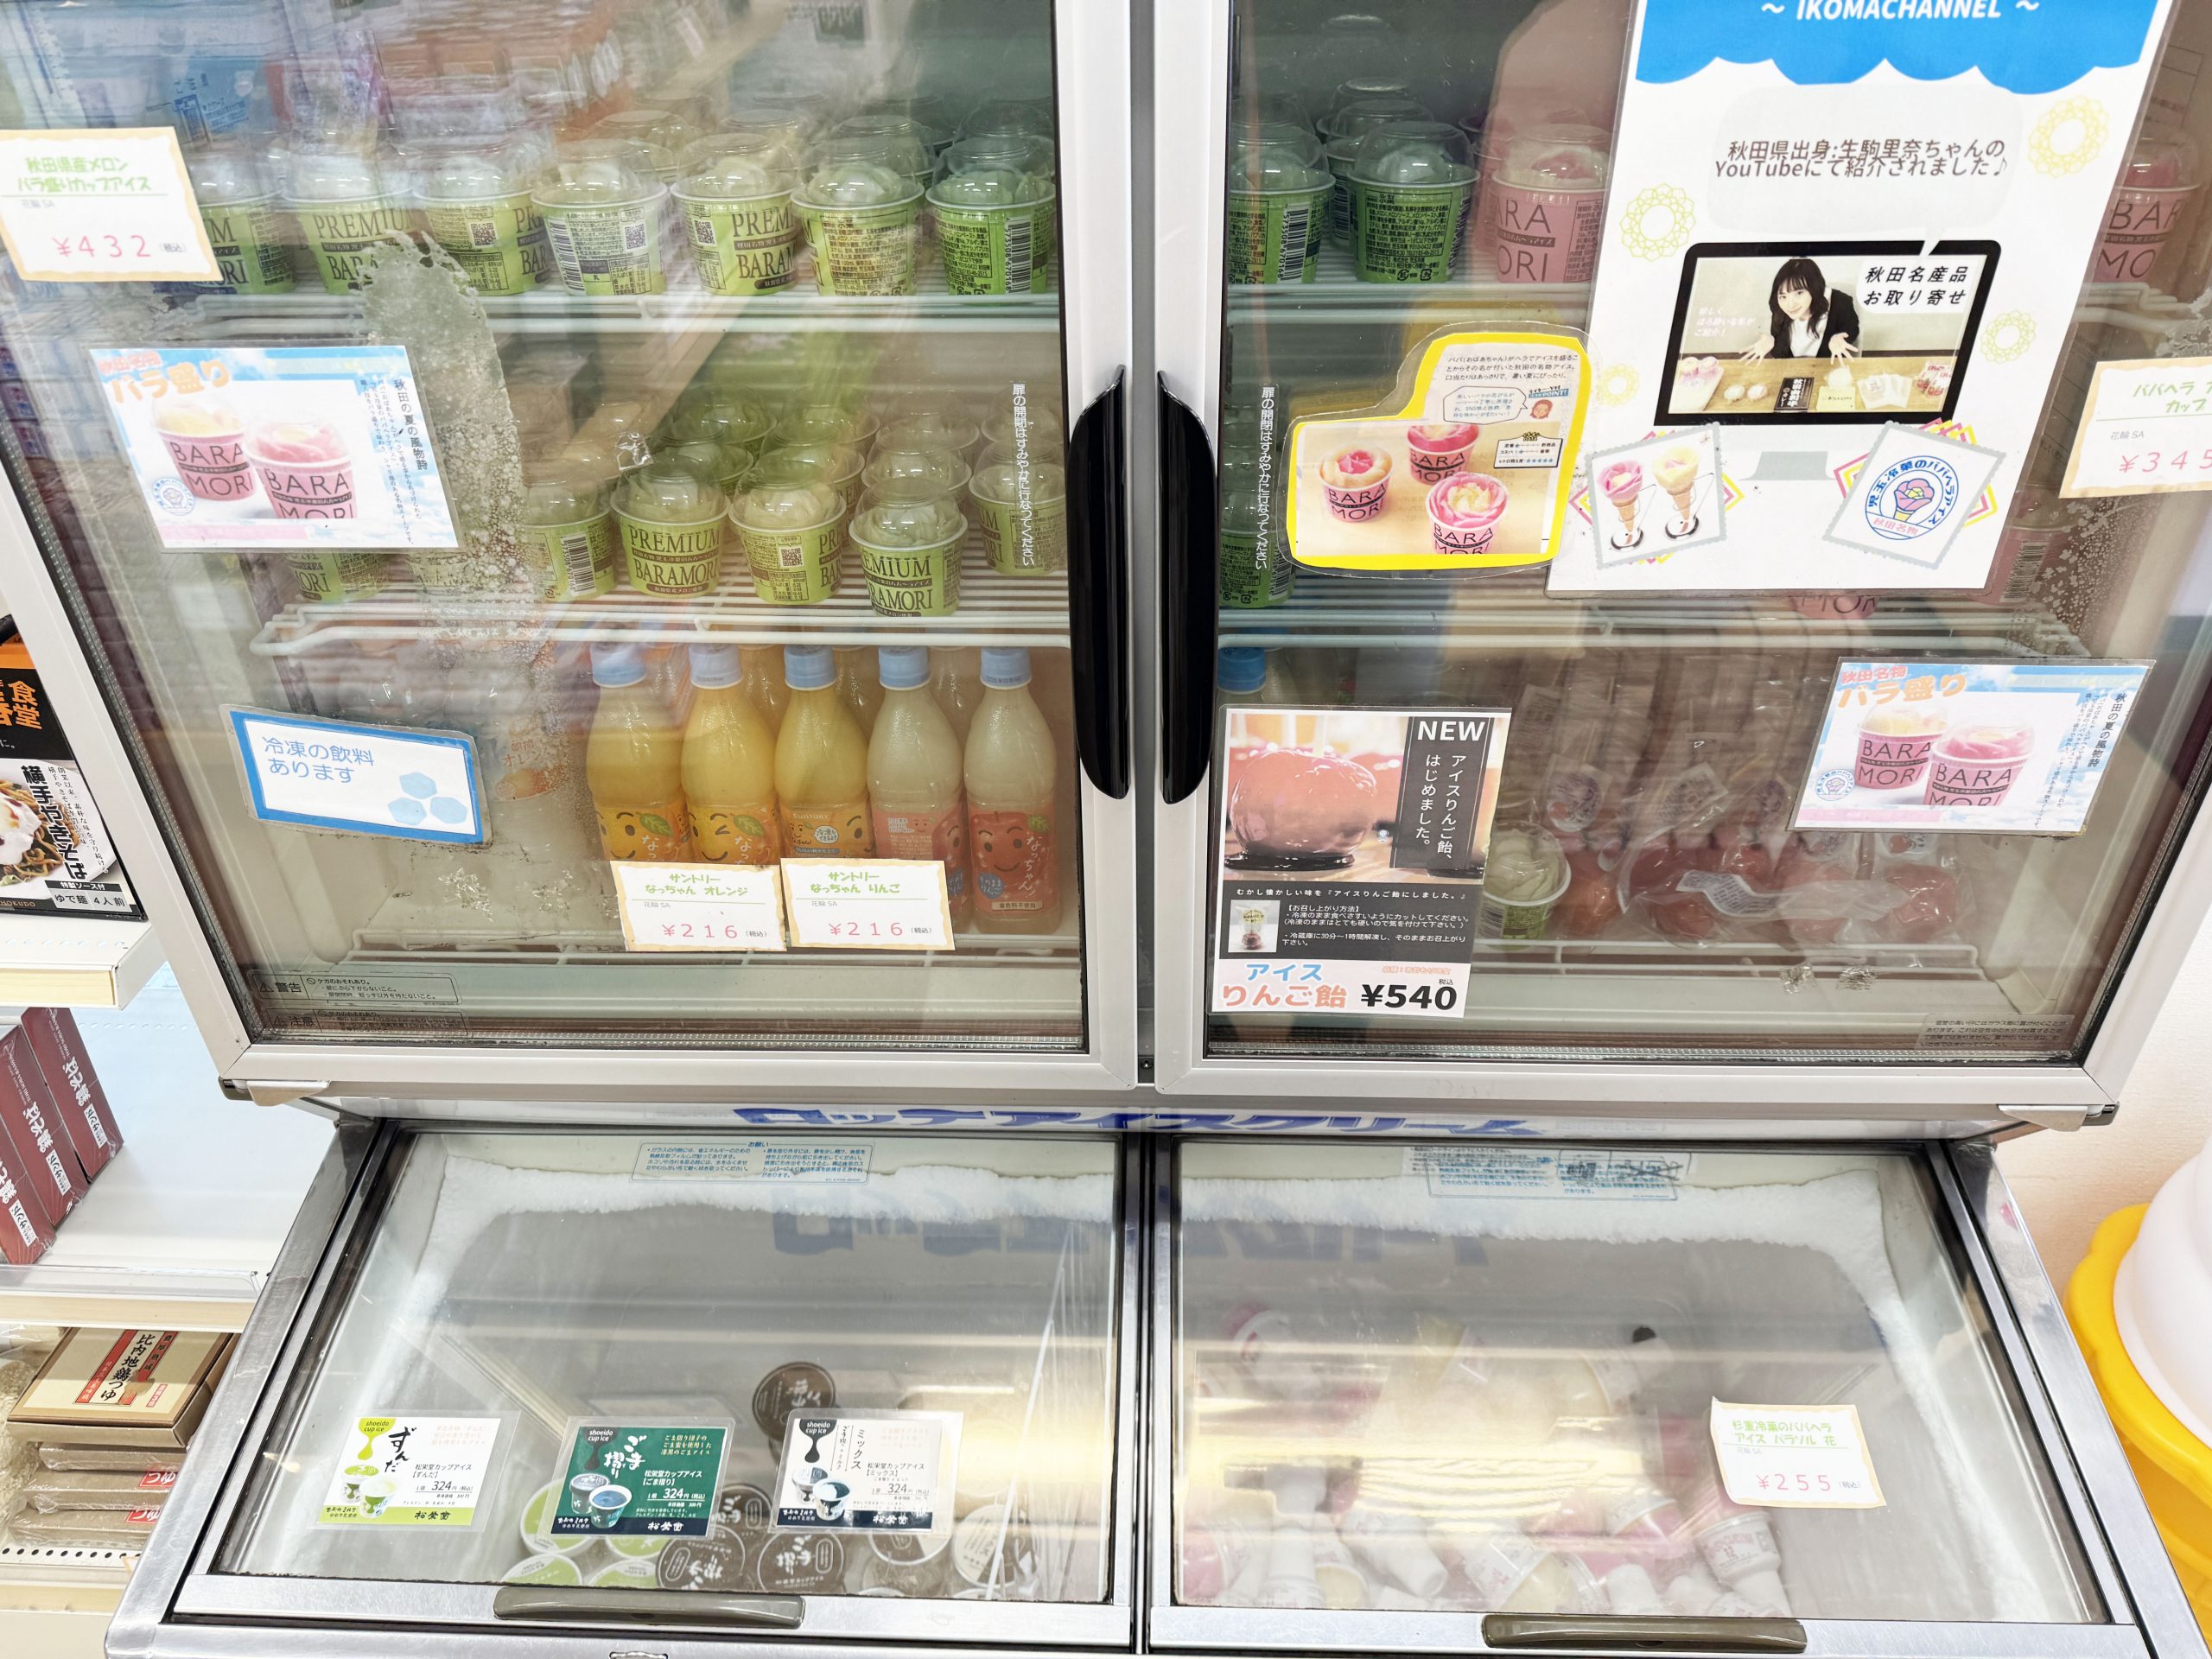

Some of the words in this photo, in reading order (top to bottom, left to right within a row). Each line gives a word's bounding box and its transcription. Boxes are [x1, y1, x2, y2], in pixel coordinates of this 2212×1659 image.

[1796, 0, 2001, 20] IKOMACHANNEL
[1728, 139, 2005, 161] 秋田県出身:生駒里奈ちゃんの
[25, 157, 129, 173] 秋田県産メロン
[17, 176, 152, 192] バラ盛りカップアイス
[733, 207, 793, 237] PREM
[1497, 200, 1551, 233] RA
[52, 234, 151, 258] ¥432
[1865, 265, 1968, 283] 秋田名産品
[1863, 289, 1967, 306] お取り寄せ
[109, 359, 231, 404] バラ盛り
[2165, 398, 2207, 413] カップ
[394, 379, 428, 470] 秋田の夏の風物詩
[169, 442, 243, 465] BARA
[185, 473, 254, 496] MORI
[264, 468, 350, 496] BARA
[1013, 384, 1035, 566] 扉の開閉はすみやかに行なってください
[1255, 387, 1275, 569] 扉の開閉はすみやかに行なってください
[1328, 483, 1386, 504] BARA
[628, 525, 720, 553] PREMIUM
[1433, 522, 1494, 544] BARA
[634, 558, 719, 586] BARAMORI
[1840, 665, 1908, 684] 秋田名物
[1837, 674, 1967, 708] バラ盛り
[8, 681, 42, 730] 食堂
[1417, 720, 1486, 741] NEW
[2088, 693, 2128, 767] 秋田の夏の風物詩
[262, 736, 374, 766] 冷凍の飲料
[1863, 740, 1931, 759] BARA
[268, 758, 355, 784] あります
[1858, 766, 1923, 785] MORI
[1936, 763, 2012, 787] BARA
[1415, 753, 1441, 845] はじめました。
[1437, 753, 1467, 859] アイスりんご飴、
[669, 874, 721, 884] サントリー
[828, 872, 880, 882] サントリー
[645, 884, 696, 895] なっちゃん
[704, 887, 748, 896] オレンジ
[810, 884, 861, 893] なっちゃん
[869, 884, 900, 893] りんご
[55, 895, 88, 905] ゆで麺
[94, 896, 125, 906] 4人前
[662, 924, 738, 938] ¥216
[829, 922, 903, 937] ¥216
[1246, 963, 1323, 982] アイス
[276, 982, 302, 993] 警告
[1223, 985, 1347, 1009] りんご飴
[1361, 984, 1458, 1010] ¥540
[734, 1108, 1541, 1135] ロッテアイスクリーム
[101, 1334, 156, 1401] 比内地鶏つゆ
[385, 1427, 417, 1473] ずんだ
[851, 1428, 866, 1470] ミックス
[1735, 1433, 1766, 1444] アイス
[1824, 1435, 1836, 1446] 花
[146, 1471, 176, 1485] つゆ
[1756, 1473, 1831, 1491] ¥255
